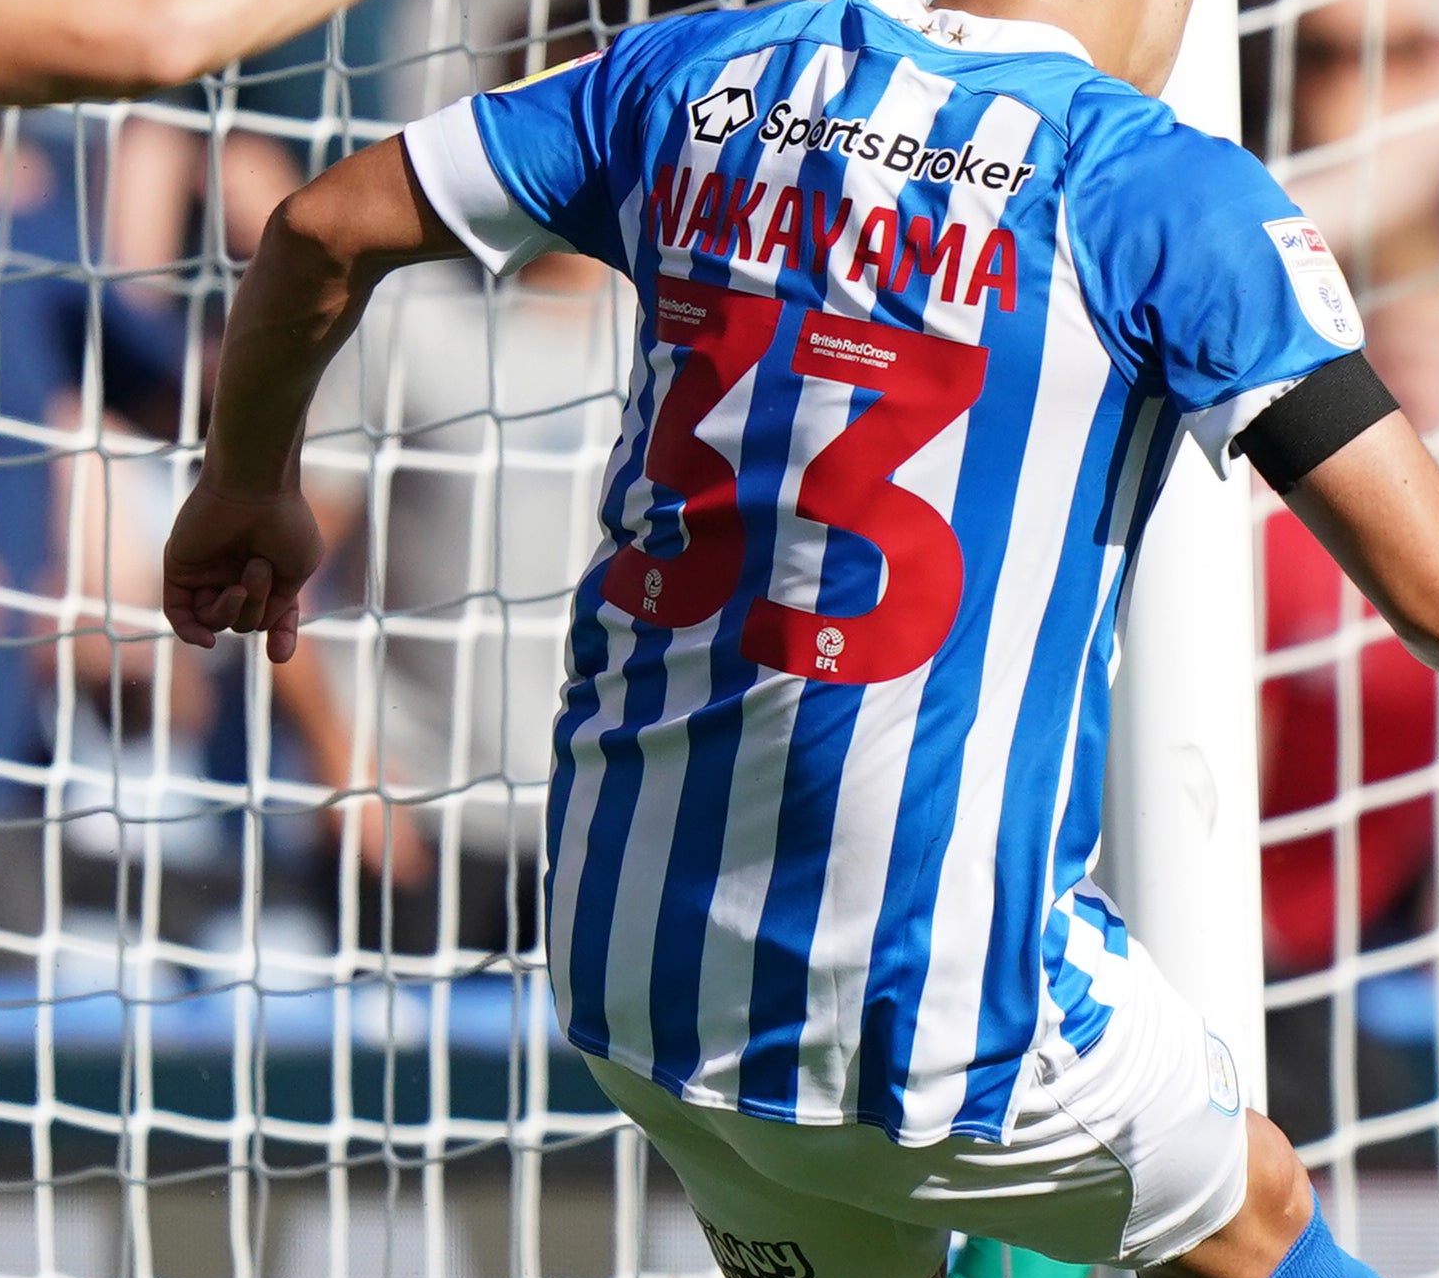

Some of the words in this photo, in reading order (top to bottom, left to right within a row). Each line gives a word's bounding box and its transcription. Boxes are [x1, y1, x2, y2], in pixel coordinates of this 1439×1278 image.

[760, 103, 1032, 193] SportsBroker
[648, 164, 1018, 312] NAKAYAMA
[810, 332, 897, 363] BritishRedCross
[601, 276, 987, 685] 33
[815, 654, 839, 673] EFL
